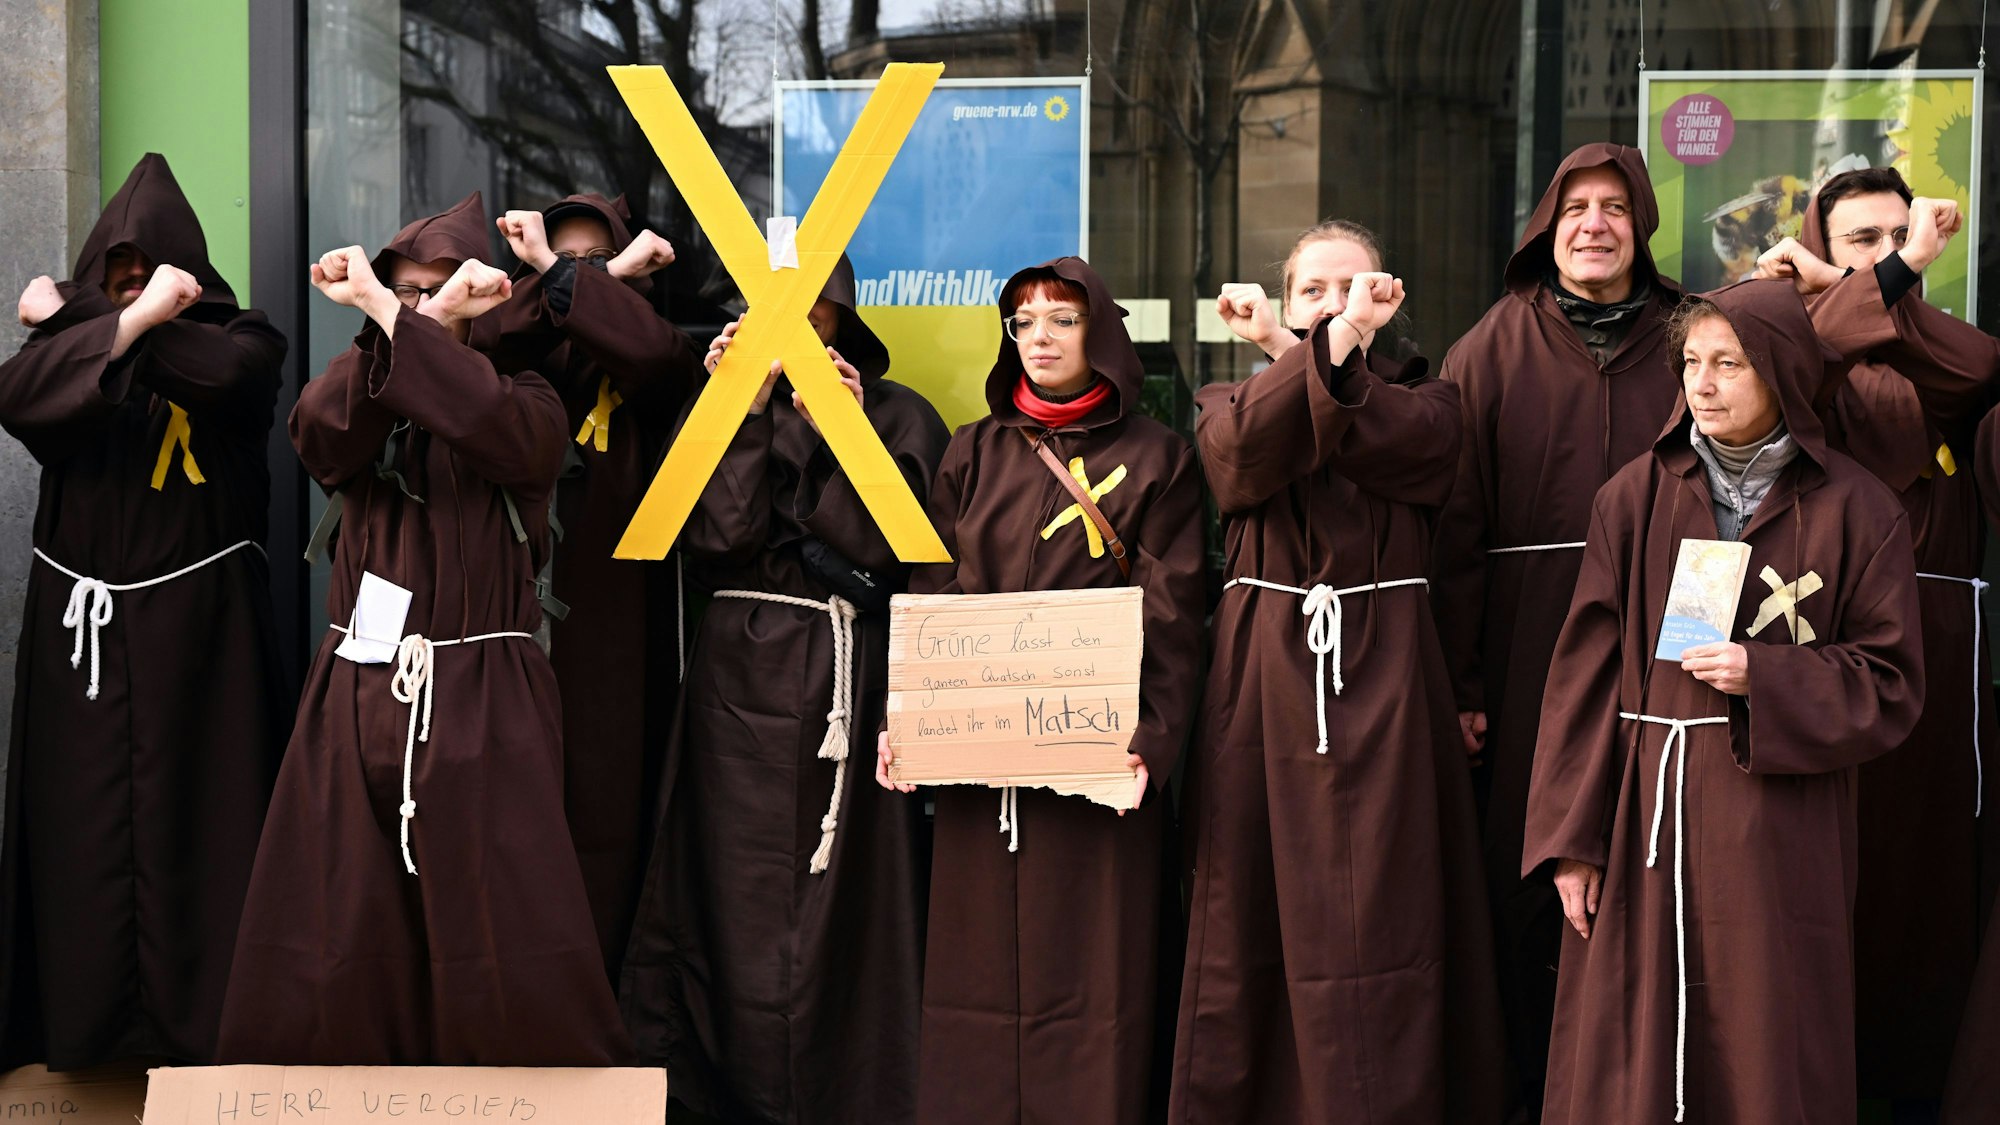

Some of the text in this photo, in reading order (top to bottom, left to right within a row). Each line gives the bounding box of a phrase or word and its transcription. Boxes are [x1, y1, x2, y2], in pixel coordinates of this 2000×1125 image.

[953, 102, 1037, 121] gruene-nrw.de
[1686, 101, 1711, 114] ALLE
[1675, 115, 1721, 128] STIMMEN
[1678, 127, 1719, 142] FÜR DEN
[1676, 143, 1719, 155] WANDEL.
[917, 614, 1101, 659] Grüne lasst den
[918, 694, 1120, 737] landet ihr im Matsch
[0, 1096, 79, 1119] mnia
[217, 1088, 331, 1125] HERR
